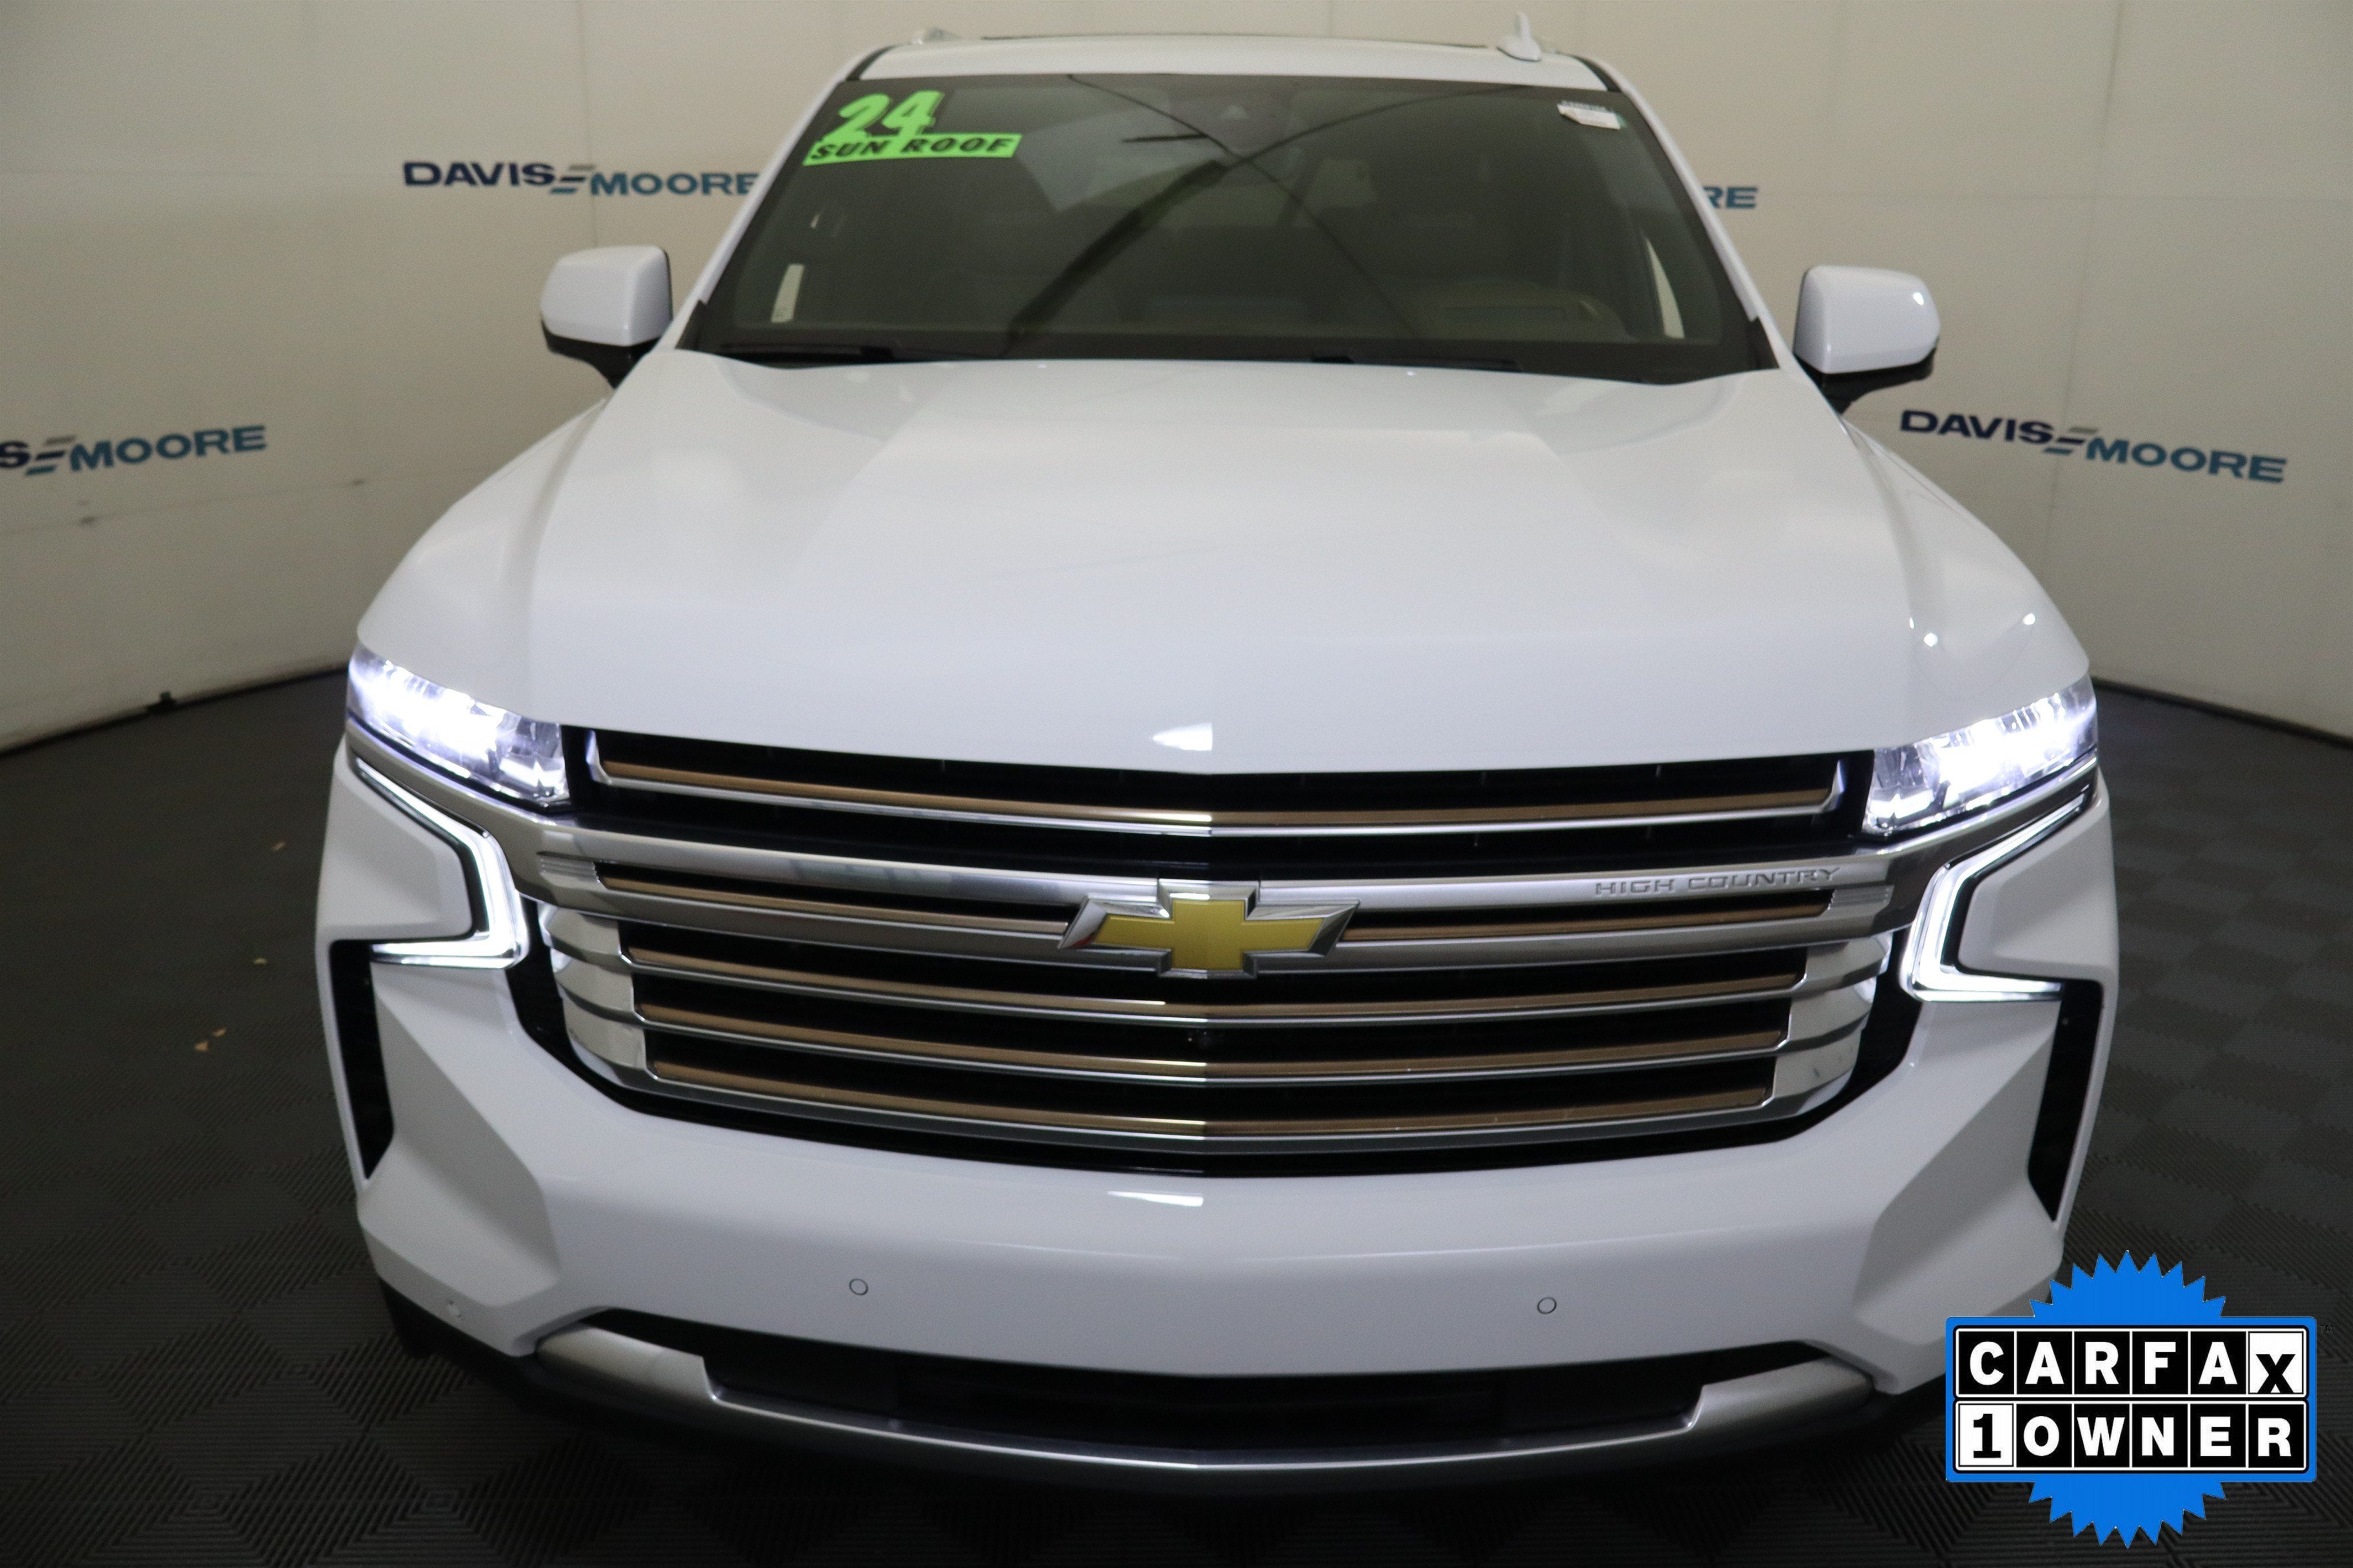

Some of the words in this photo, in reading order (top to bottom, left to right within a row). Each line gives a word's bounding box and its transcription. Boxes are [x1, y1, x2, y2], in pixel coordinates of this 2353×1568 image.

[823, 90, 944, 142] 24
[811, 140, 890, 160] SUN
[901, 138, 1015, 153] ROOF
[403, 161, 556, 187] DAVIS
[70, 424, 267, 472] MOORE
[1900, 410, 2054, 445] DAVIS
[2086, 437, 2287, 484] MOORE
[1595, 879, 1675, 897] HIGH
[1688, 867, 1840, 890] COUNTRY
